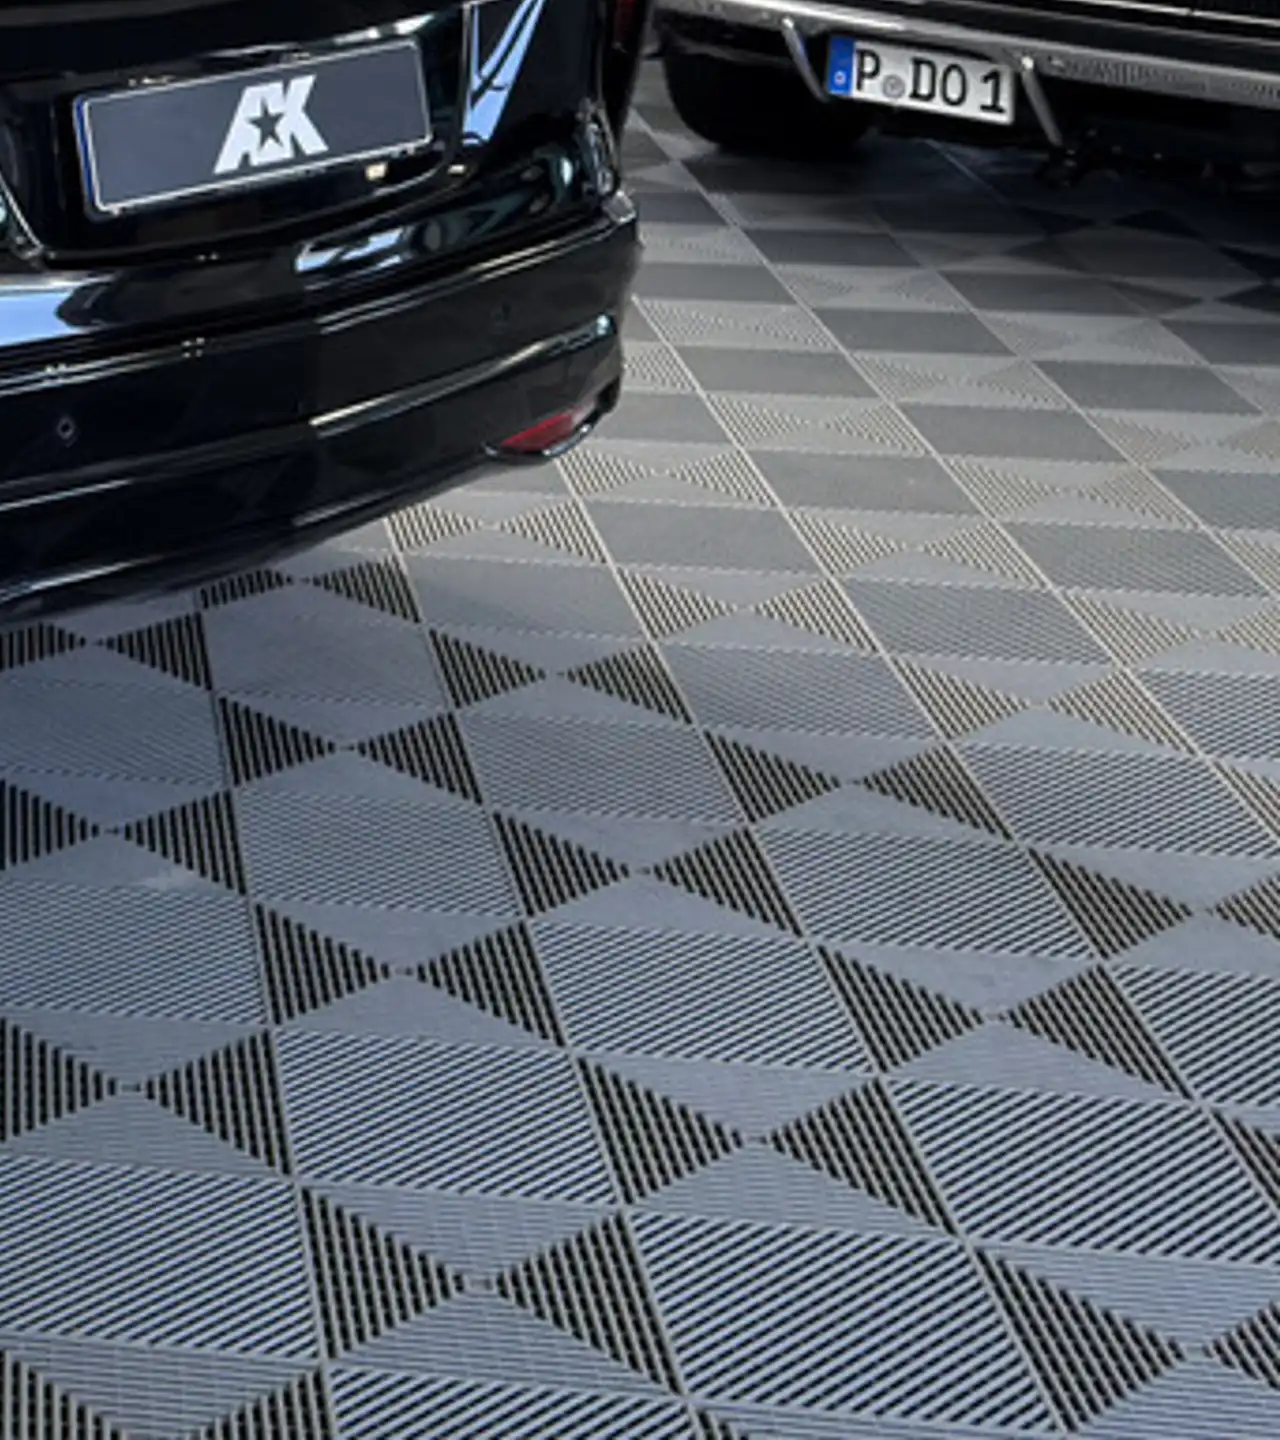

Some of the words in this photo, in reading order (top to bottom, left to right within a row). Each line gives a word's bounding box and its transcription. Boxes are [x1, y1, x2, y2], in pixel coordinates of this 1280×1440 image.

[856, 49, 881, 90] P
[909, 57, 968, 107] DO
[979, 69, 1006, 114] 1
[213, 74, 330, 175] AK
